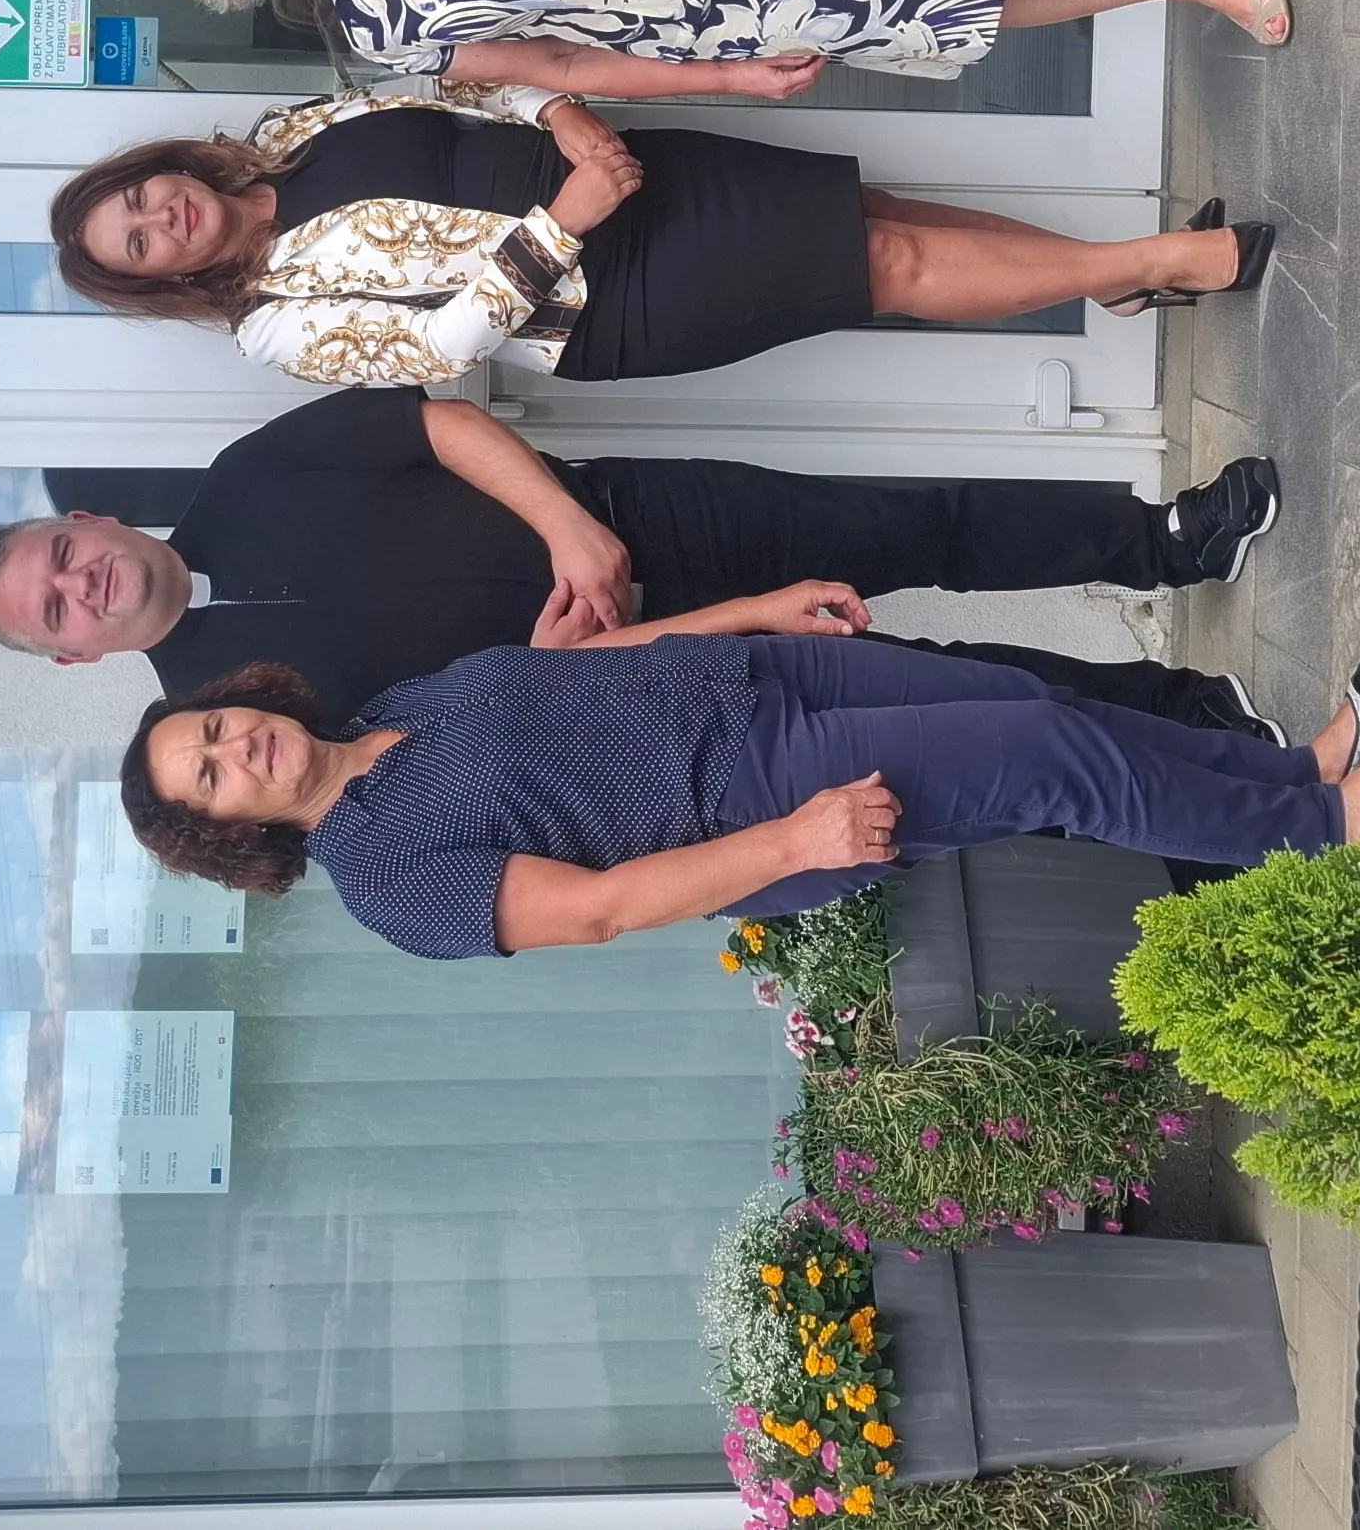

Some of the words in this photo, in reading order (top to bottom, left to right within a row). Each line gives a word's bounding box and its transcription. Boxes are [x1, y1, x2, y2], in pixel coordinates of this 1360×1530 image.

[33, 36, 42, 78] OBJEKT
[135, 1028, 143, 1046] DIST
[142, 1083, 152, 1103] 2024
